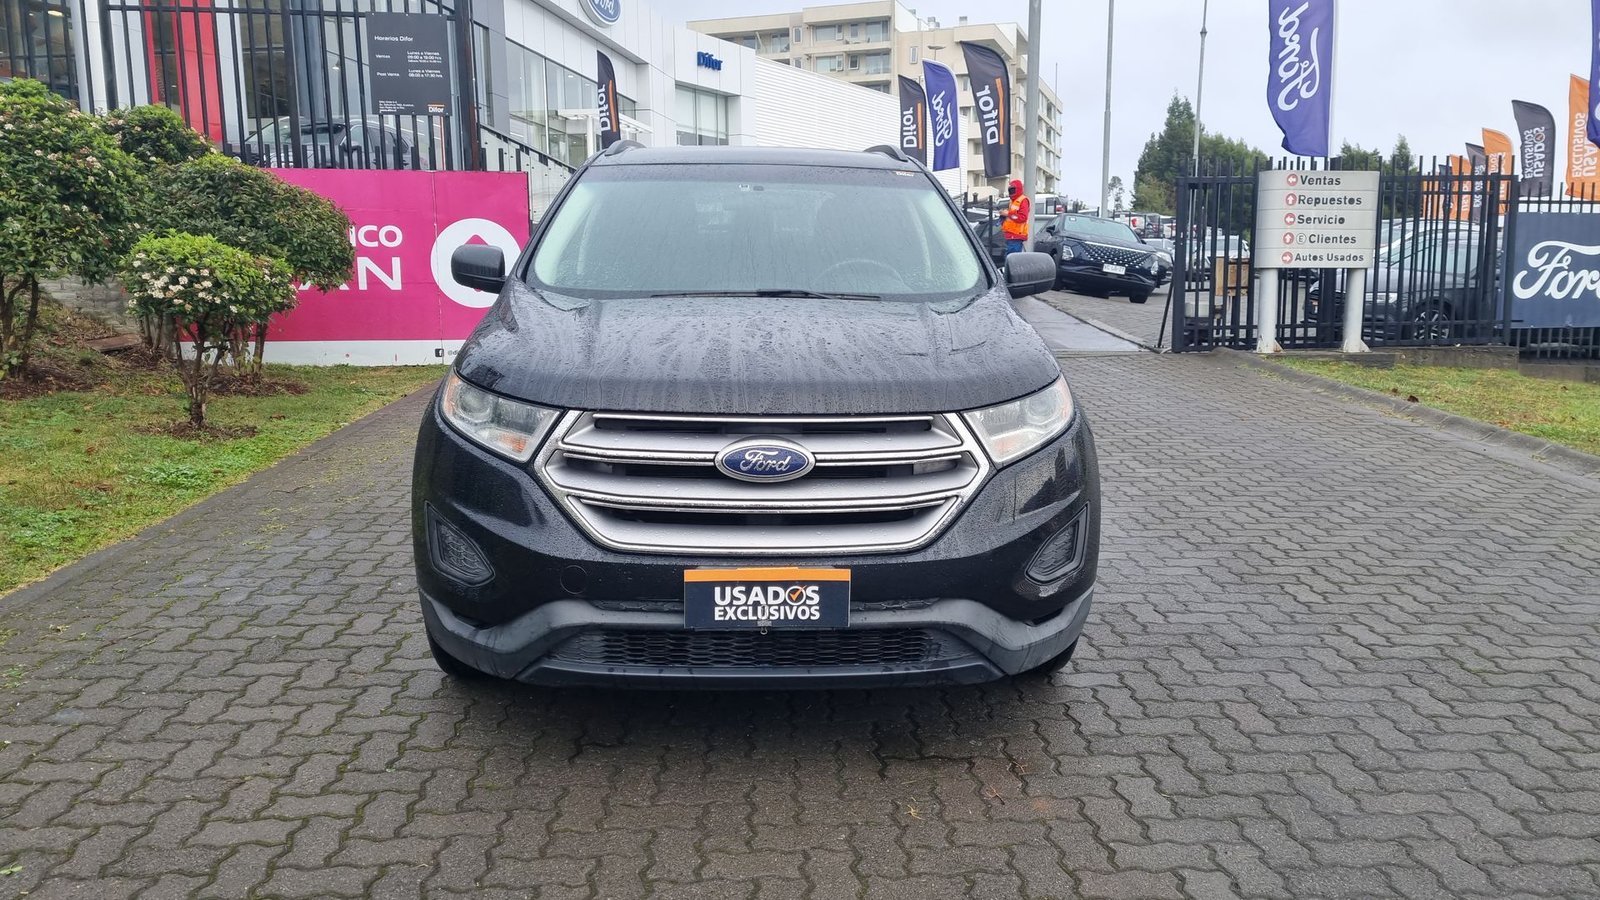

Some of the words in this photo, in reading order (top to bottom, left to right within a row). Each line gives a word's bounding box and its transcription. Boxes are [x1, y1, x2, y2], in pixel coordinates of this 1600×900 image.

[696, 51, 723, 71] Difor
[1300, 175, 1341, 186] Ventas
[1298, 194, 1362, 207] Repuestos
[1297, 214, 1345, 225] Servicio
[349, 224, 403, 248] ICO
[1308, 234, 1357, 244] Clientes
[1294, 253, 1324, 262] Autos
[1326, 253, 1364, 262] Usados
[1512, 240, 1600, 299] For
[739, 449, 792, 473] Ford
[714, 585, 820, 606] USADOS
[714, 605, 820, 621] EXCLUSIVOS
